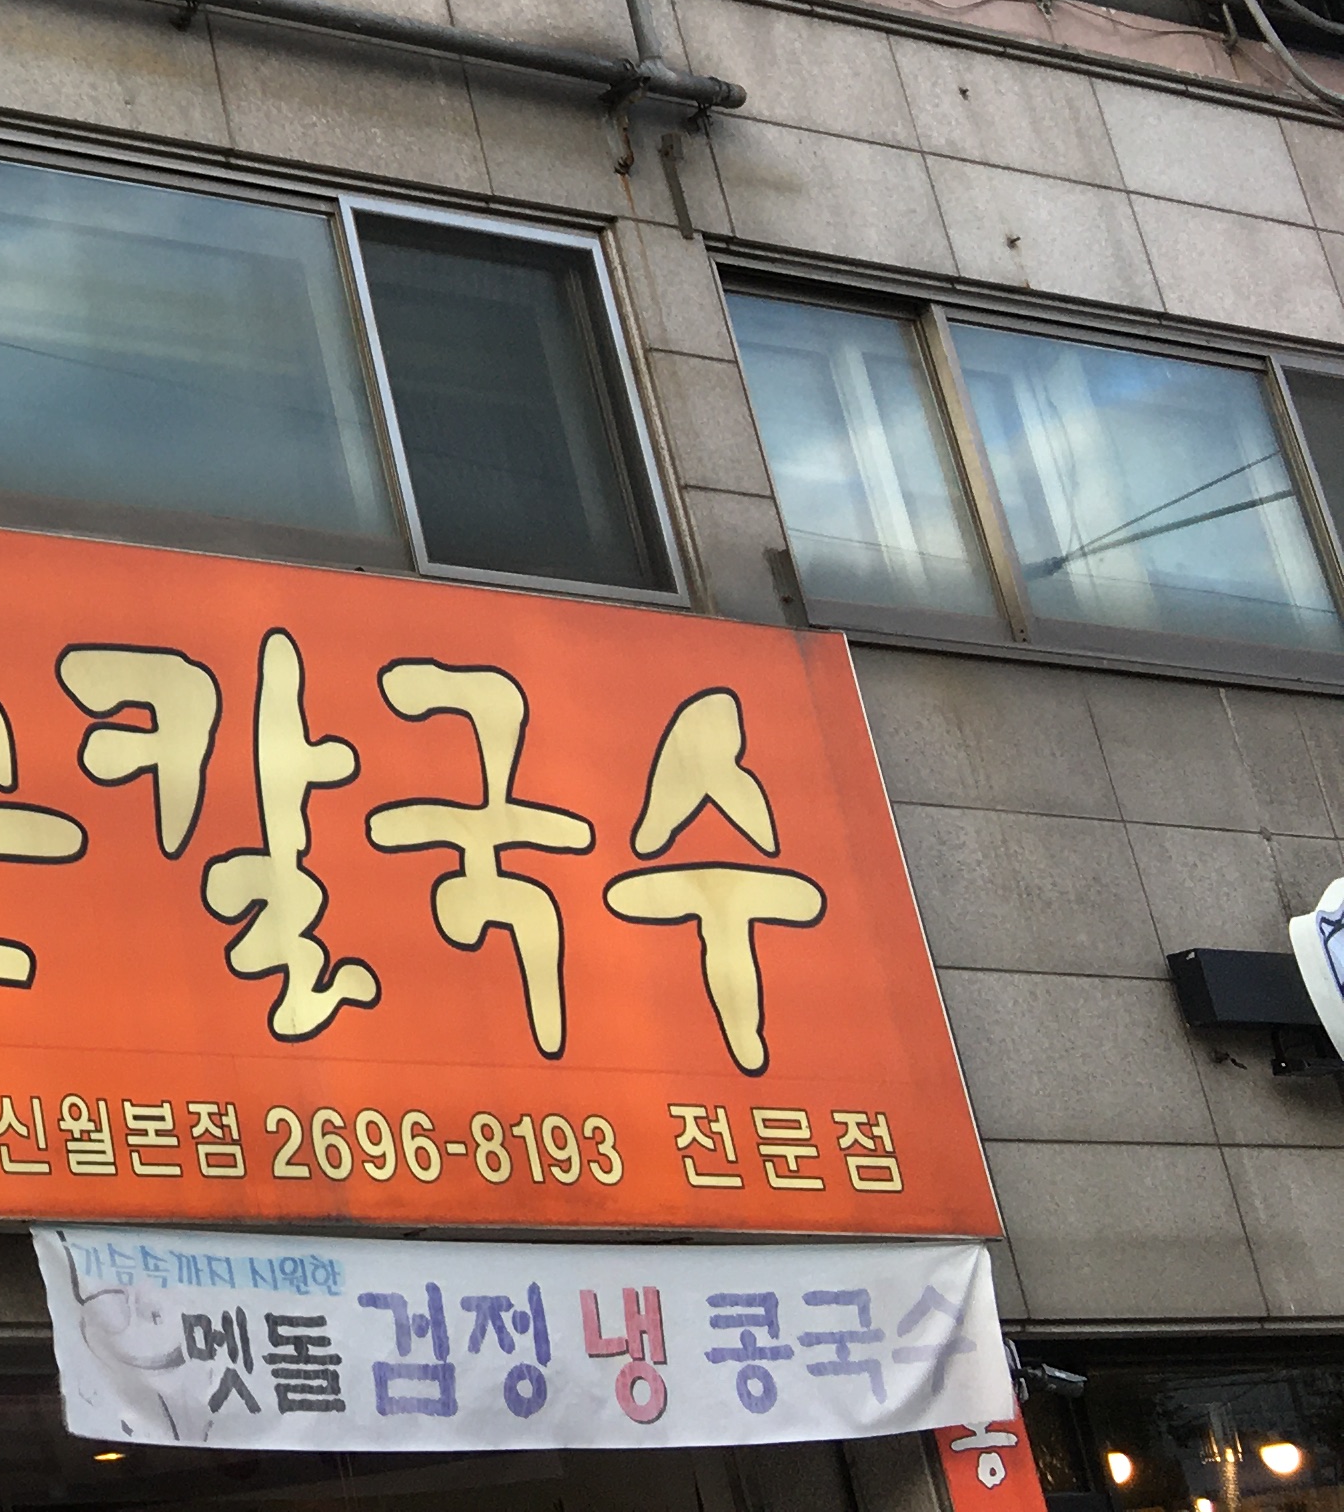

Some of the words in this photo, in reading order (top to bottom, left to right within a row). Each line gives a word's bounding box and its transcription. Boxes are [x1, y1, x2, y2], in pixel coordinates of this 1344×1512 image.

[264, 1104, 624, 1186] 2696-8193
[667, 1101, 905, 1193] 전문점
[71, 1242, 237, 1289] 가슴속까지
[248, 1254, 342, 1297] 시원한
[181, 1305, 346, 1416] 멧돌
[357, 1281, 552, 1419] 검정
[580, 1285, 668, 1425] 냉
[704, 1284, 978, 1415] 콩국수
